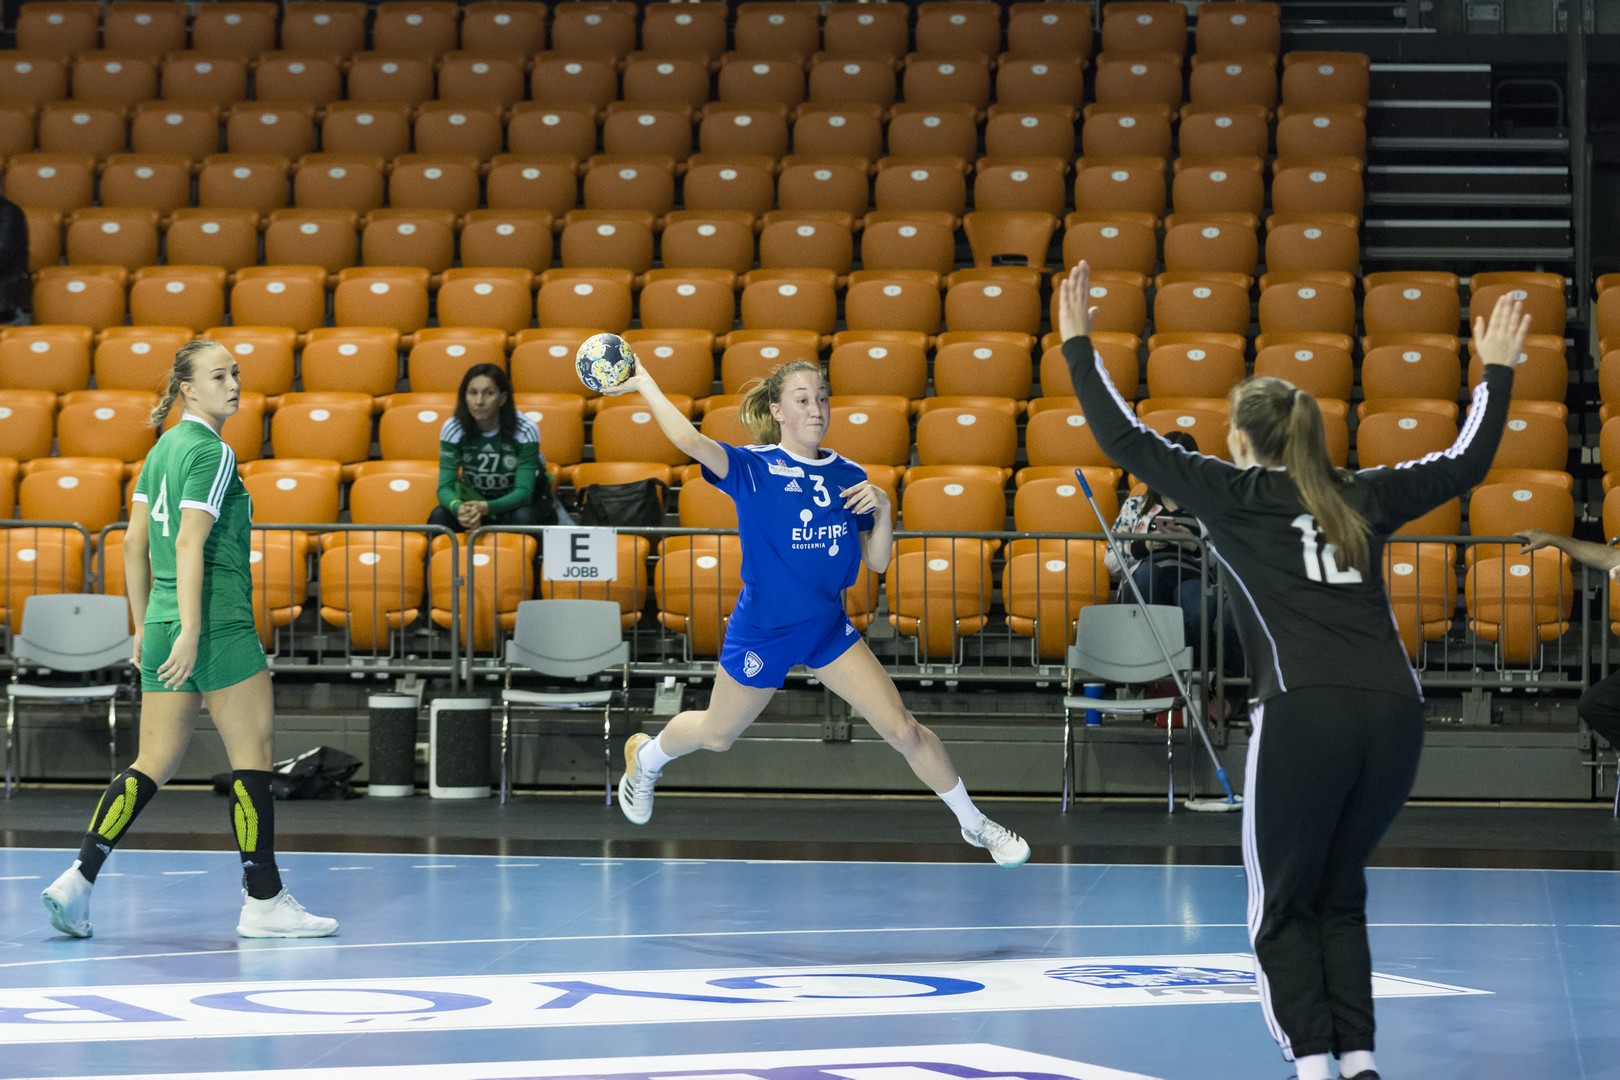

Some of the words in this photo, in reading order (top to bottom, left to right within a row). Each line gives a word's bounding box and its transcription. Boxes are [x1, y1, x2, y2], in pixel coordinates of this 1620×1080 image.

[477, 453, 500, 473] 27
[809, 474, 831, 508] 3
[150, 474, 170, 537] 4
[570, 533, 591, 563] E
[791, 542, 826, 550] GEOTERMIA
[562, 566, 599, 578] JOBB
